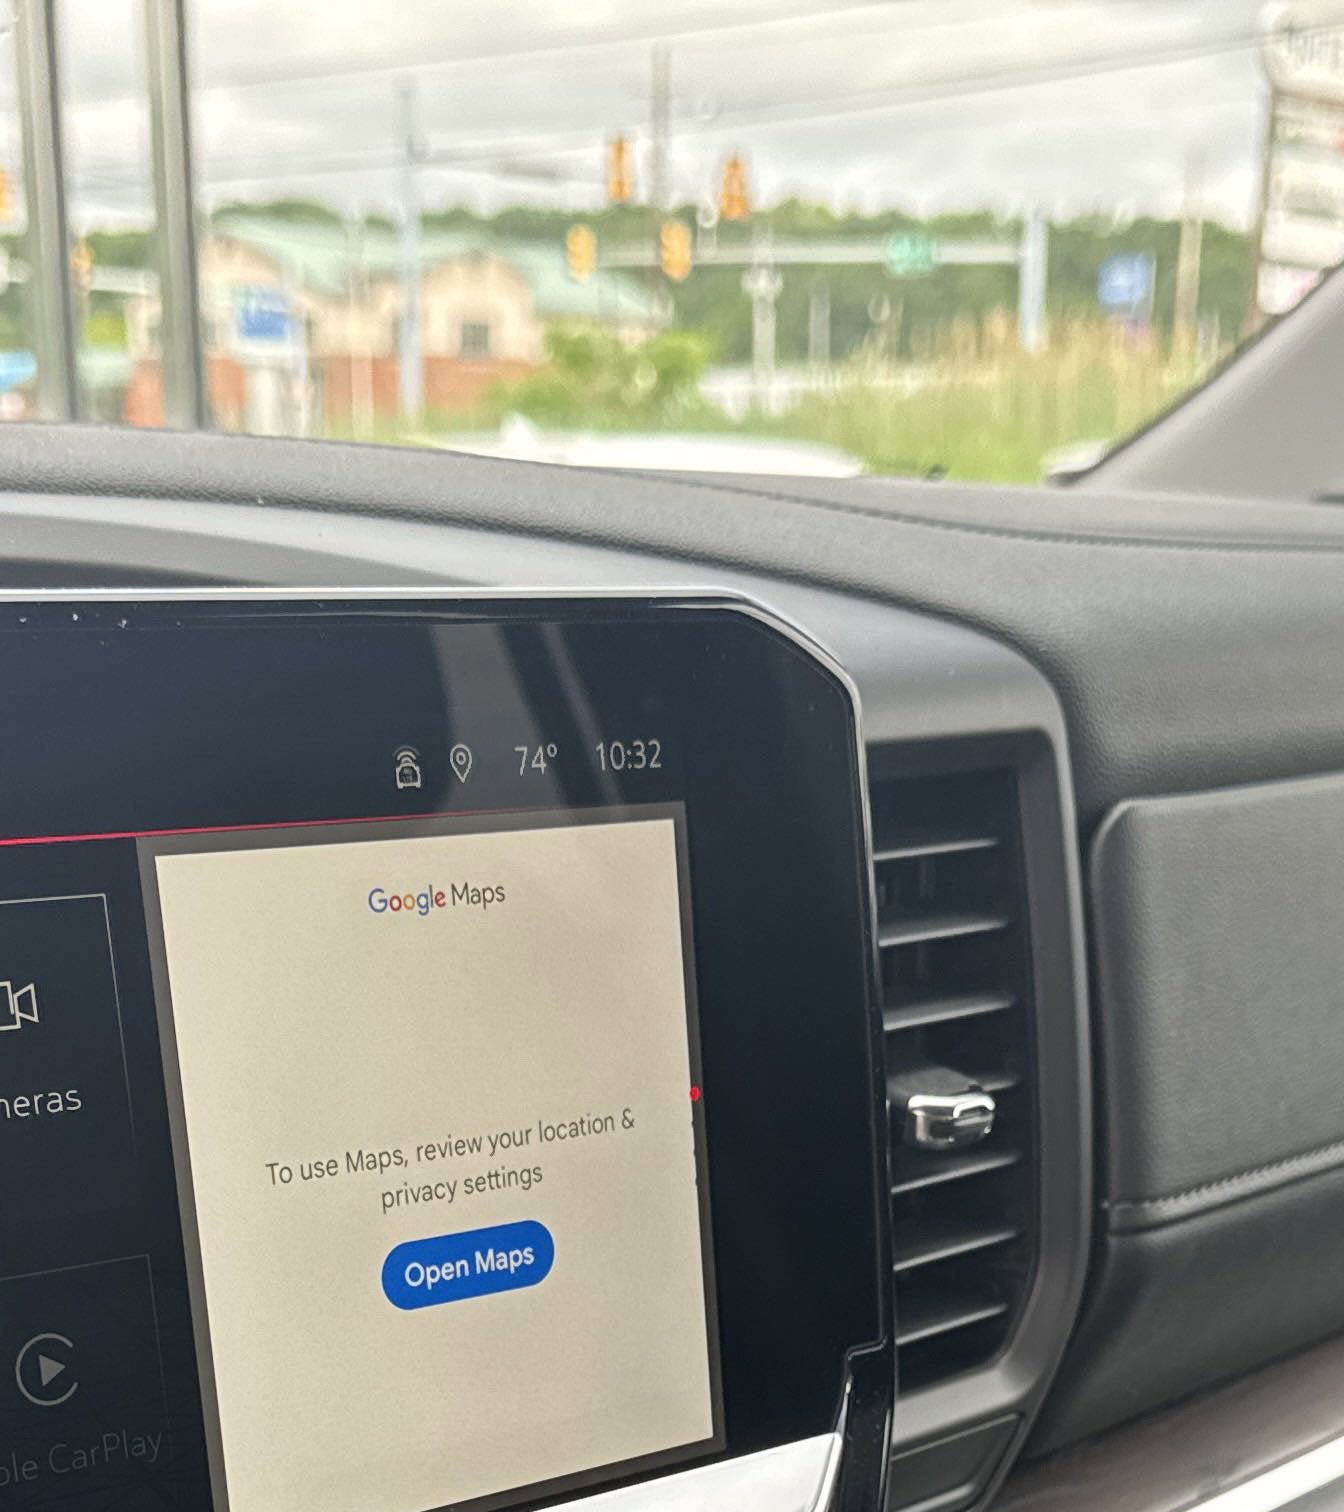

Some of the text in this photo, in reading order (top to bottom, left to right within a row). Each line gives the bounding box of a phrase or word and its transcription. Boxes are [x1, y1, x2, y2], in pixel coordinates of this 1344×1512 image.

[595, 740, 662, 772] 10:32
[367, 883, 507, 917] Google Maps
[265, 1108, 636, 1187] To use Maps, review your location &
[380, 1161, 544, 1216] privacy settings
[404, 1242, 536, 1292] Open Maps
[48, 1428, 165, 1476] CarPlay
